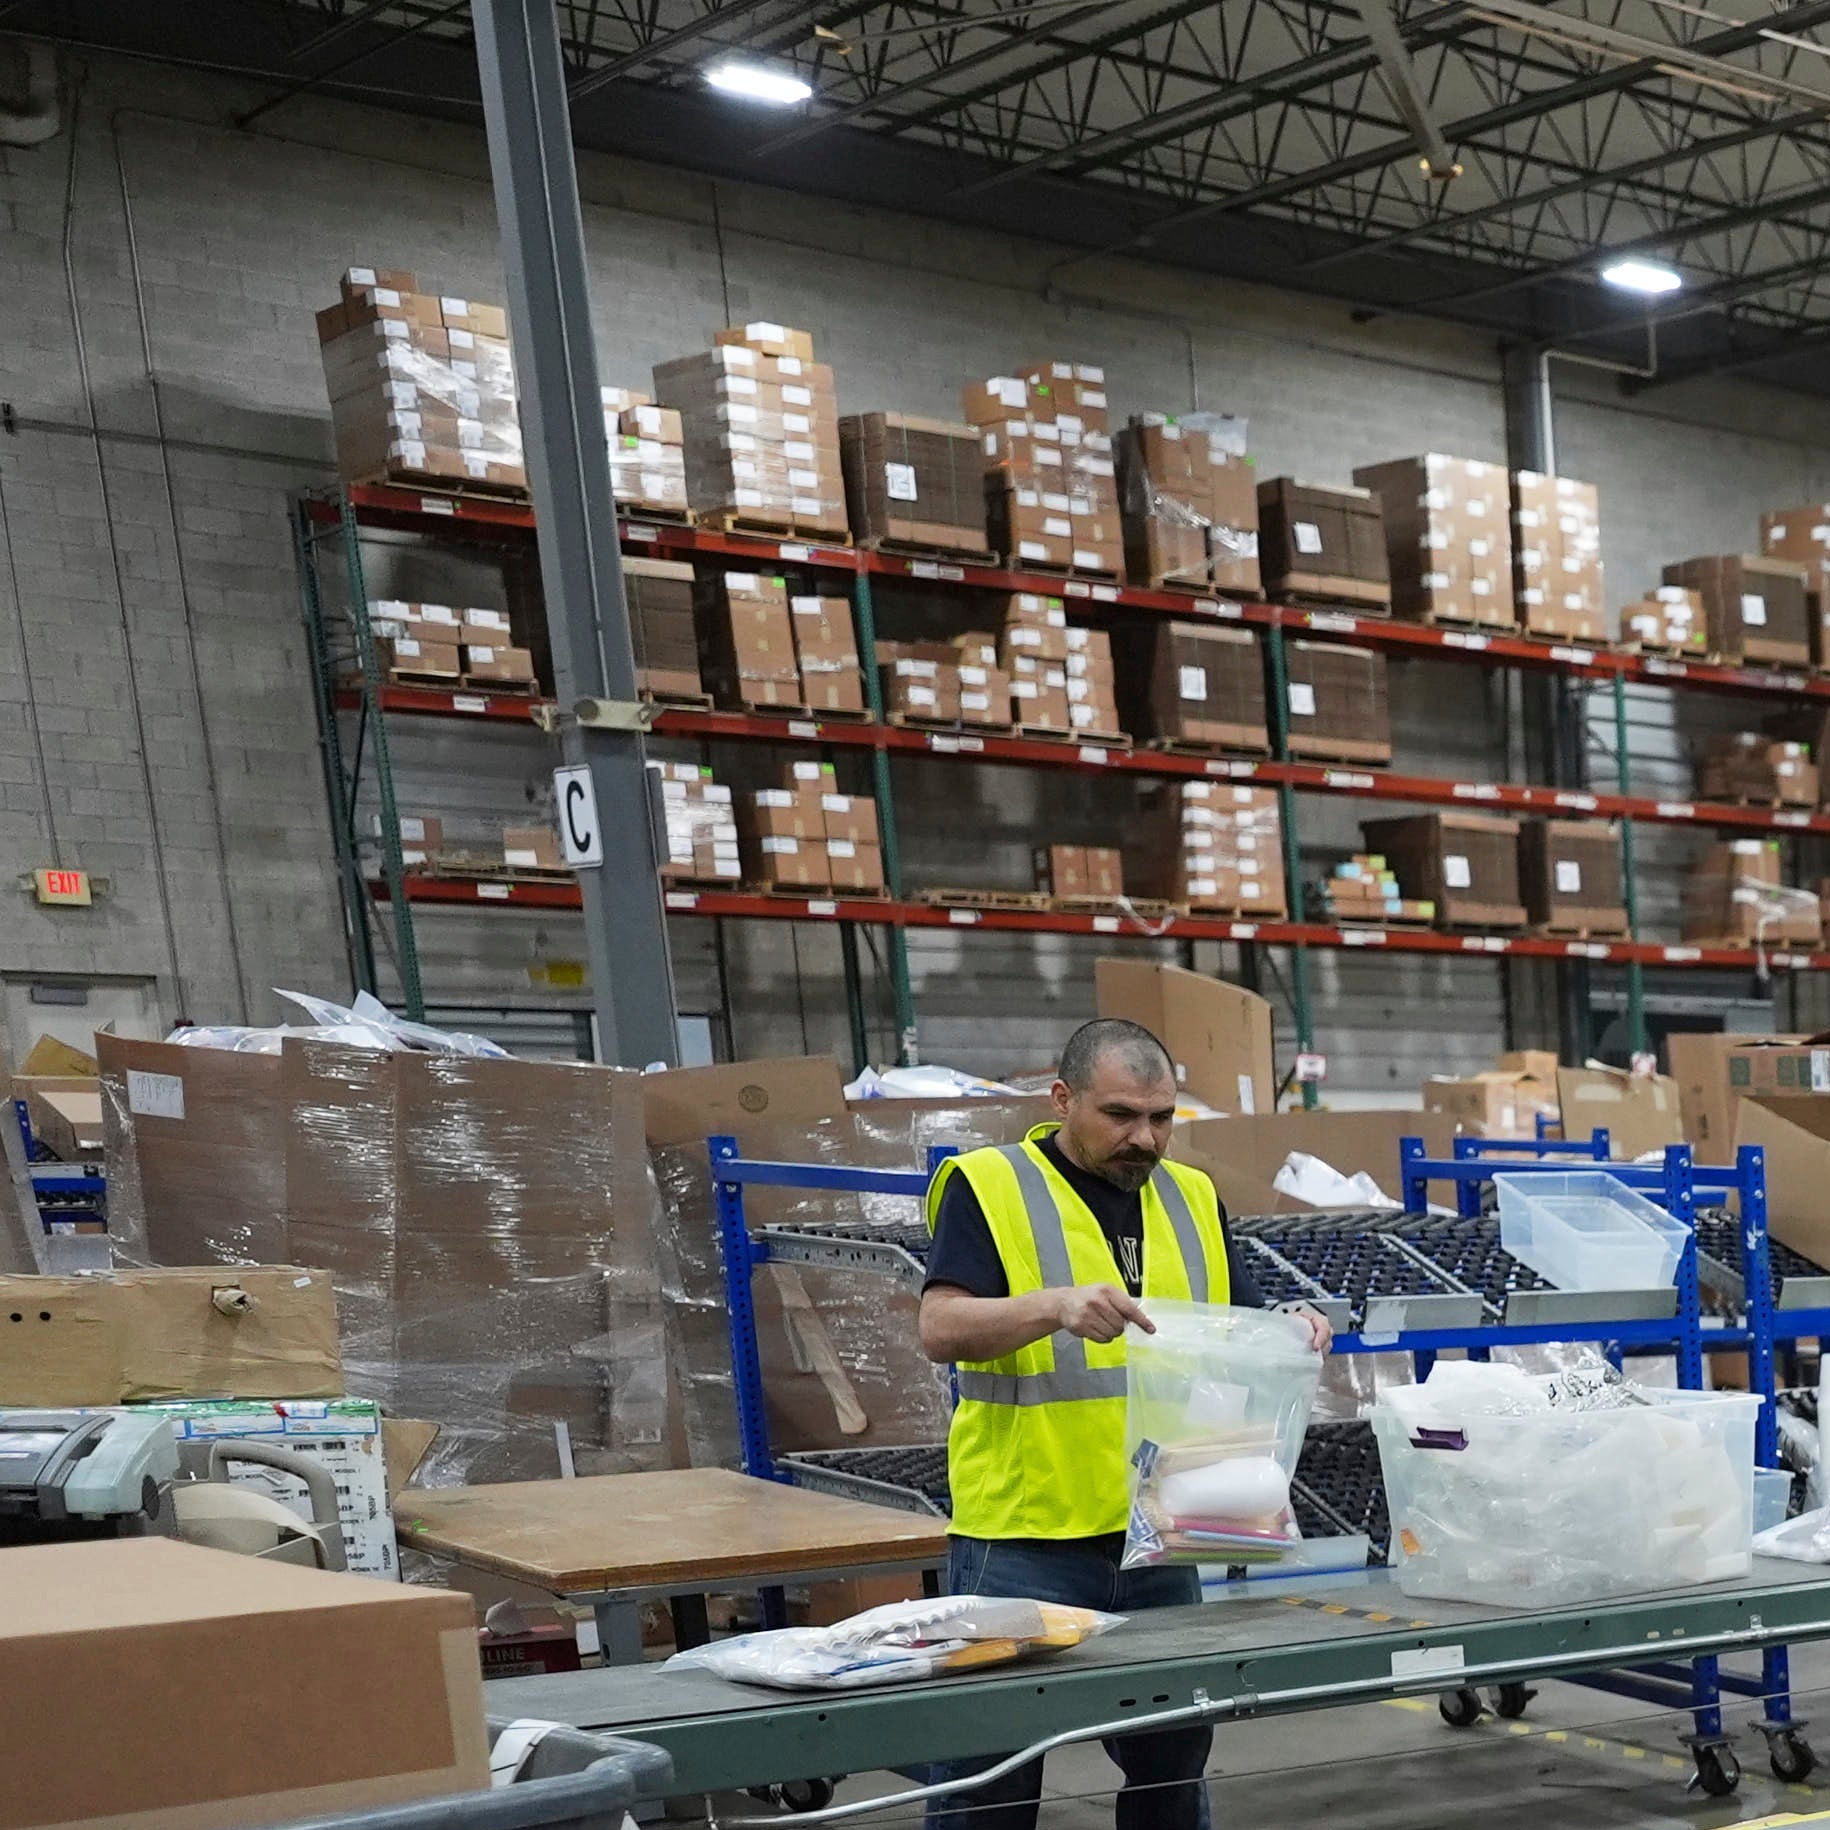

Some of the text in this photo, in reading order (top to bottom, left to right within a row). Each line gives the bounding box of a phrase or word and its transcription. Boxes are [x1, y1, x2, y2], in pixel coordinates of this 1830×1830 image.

[567, 780, 591, 853] C
[47, 872, 81, 894] EXIT
[481, 1647, 526, 1665] LINE
